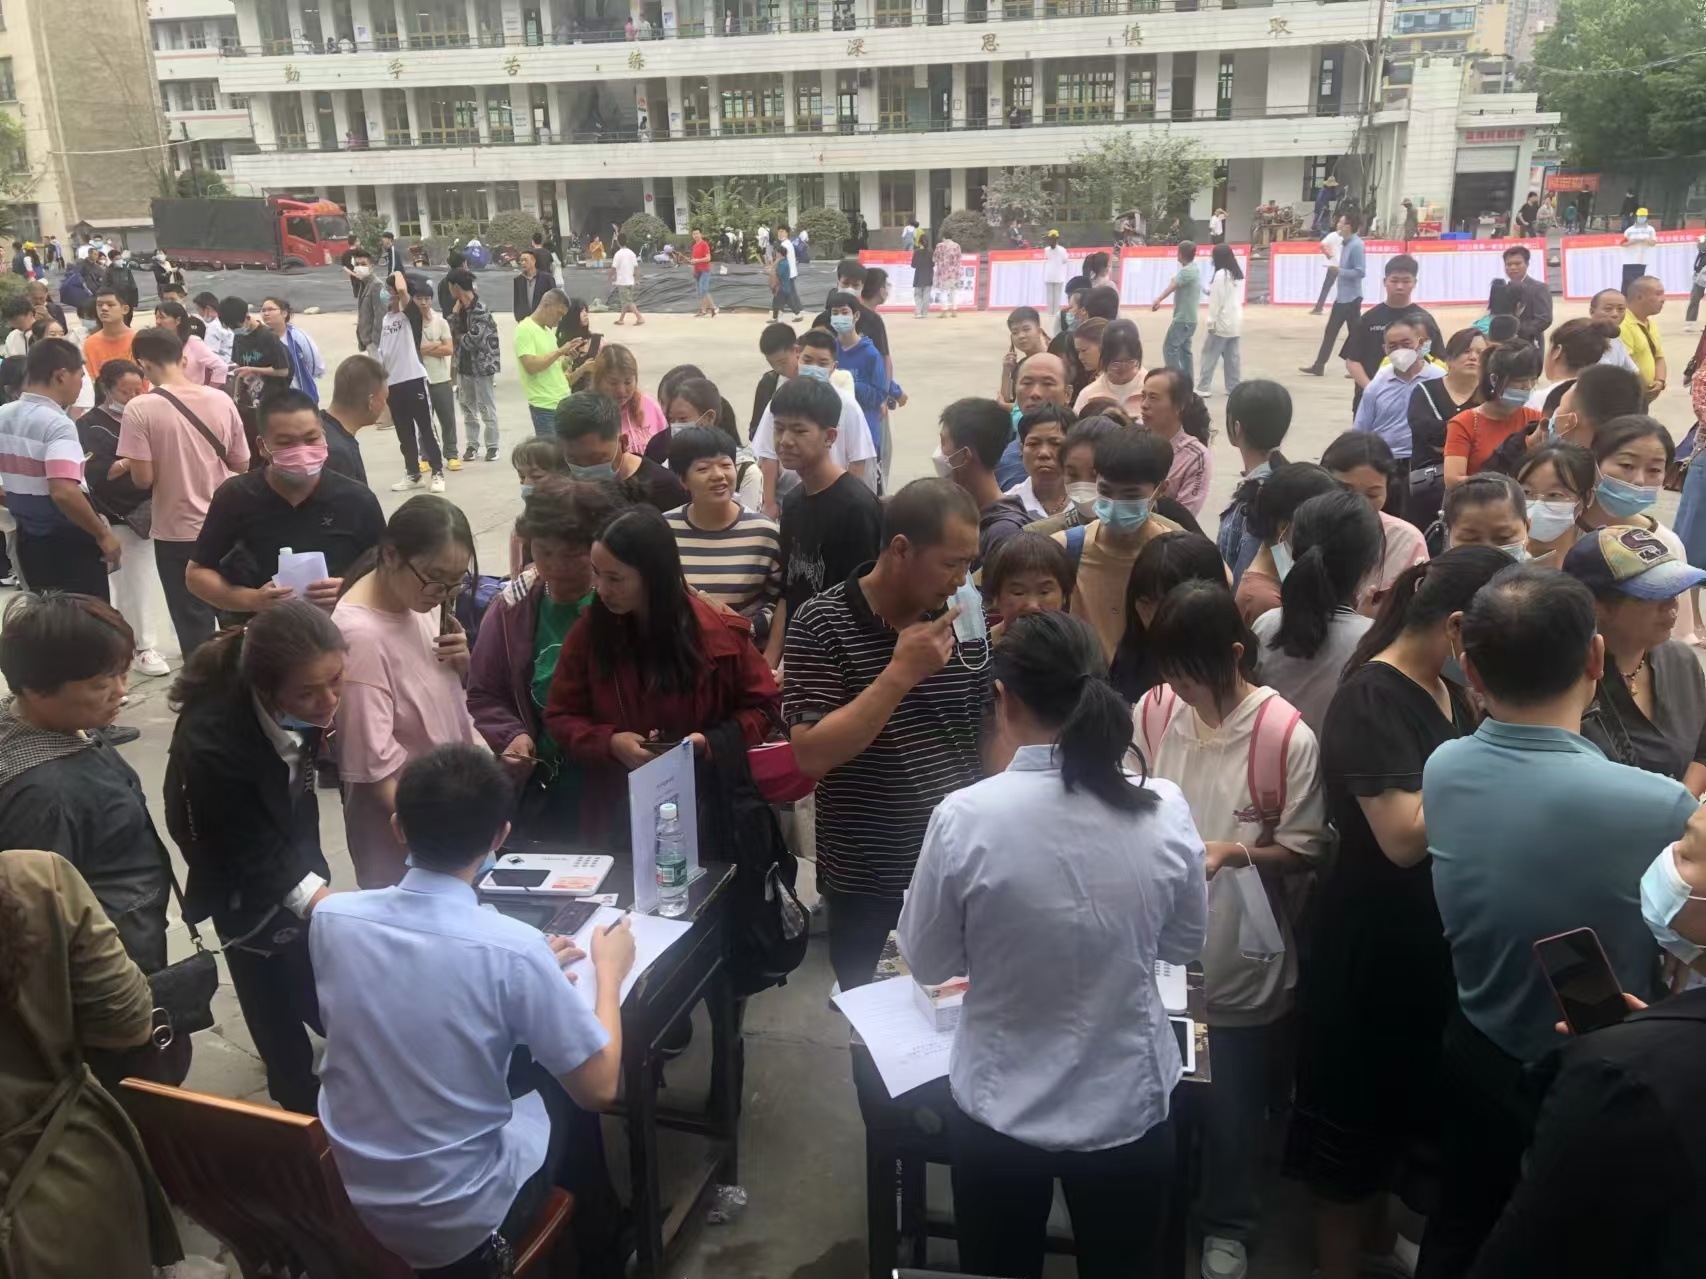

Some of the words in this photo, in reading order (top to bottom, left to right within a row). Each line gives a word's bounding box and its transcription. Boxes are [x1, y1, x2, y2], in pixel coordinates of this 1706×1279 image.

[284, 64, 300, 83] 勤
[503, 56, 520, 76] 苦
[847, 38, 867, 57] 深
[981, 33, 1000, 52] 思
[1123, 22, 1143, 46] 慎
[1268, 16, 1292, 38] 取
